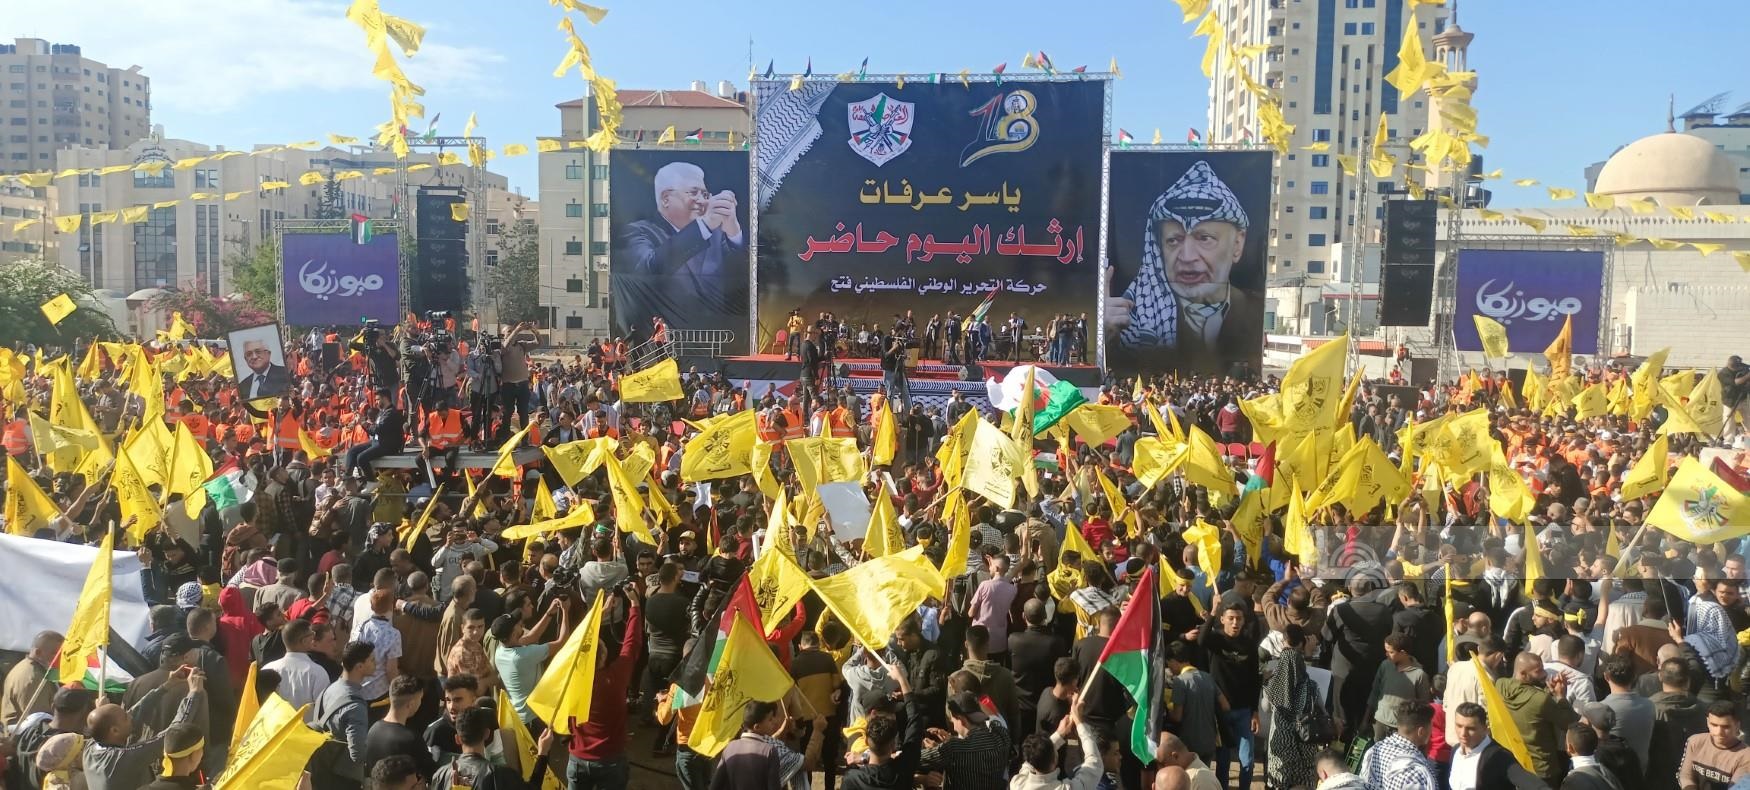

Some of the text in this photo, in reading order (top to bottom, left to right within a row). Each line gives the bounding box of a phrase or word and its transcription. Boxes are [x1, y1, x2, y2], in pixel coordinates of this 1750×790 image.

[860, 179, 1020, 212] ياسر عرفات
[799, 218, 1084, 265] إرثك اليوم حاضر
[299, 260, 383, 300] ميوزيكا
[830, 275, 1048, 296] حركة التحرير الوطني الفلسطيني فتح
[1476, 279, 1582, 325] ميوزيكا
